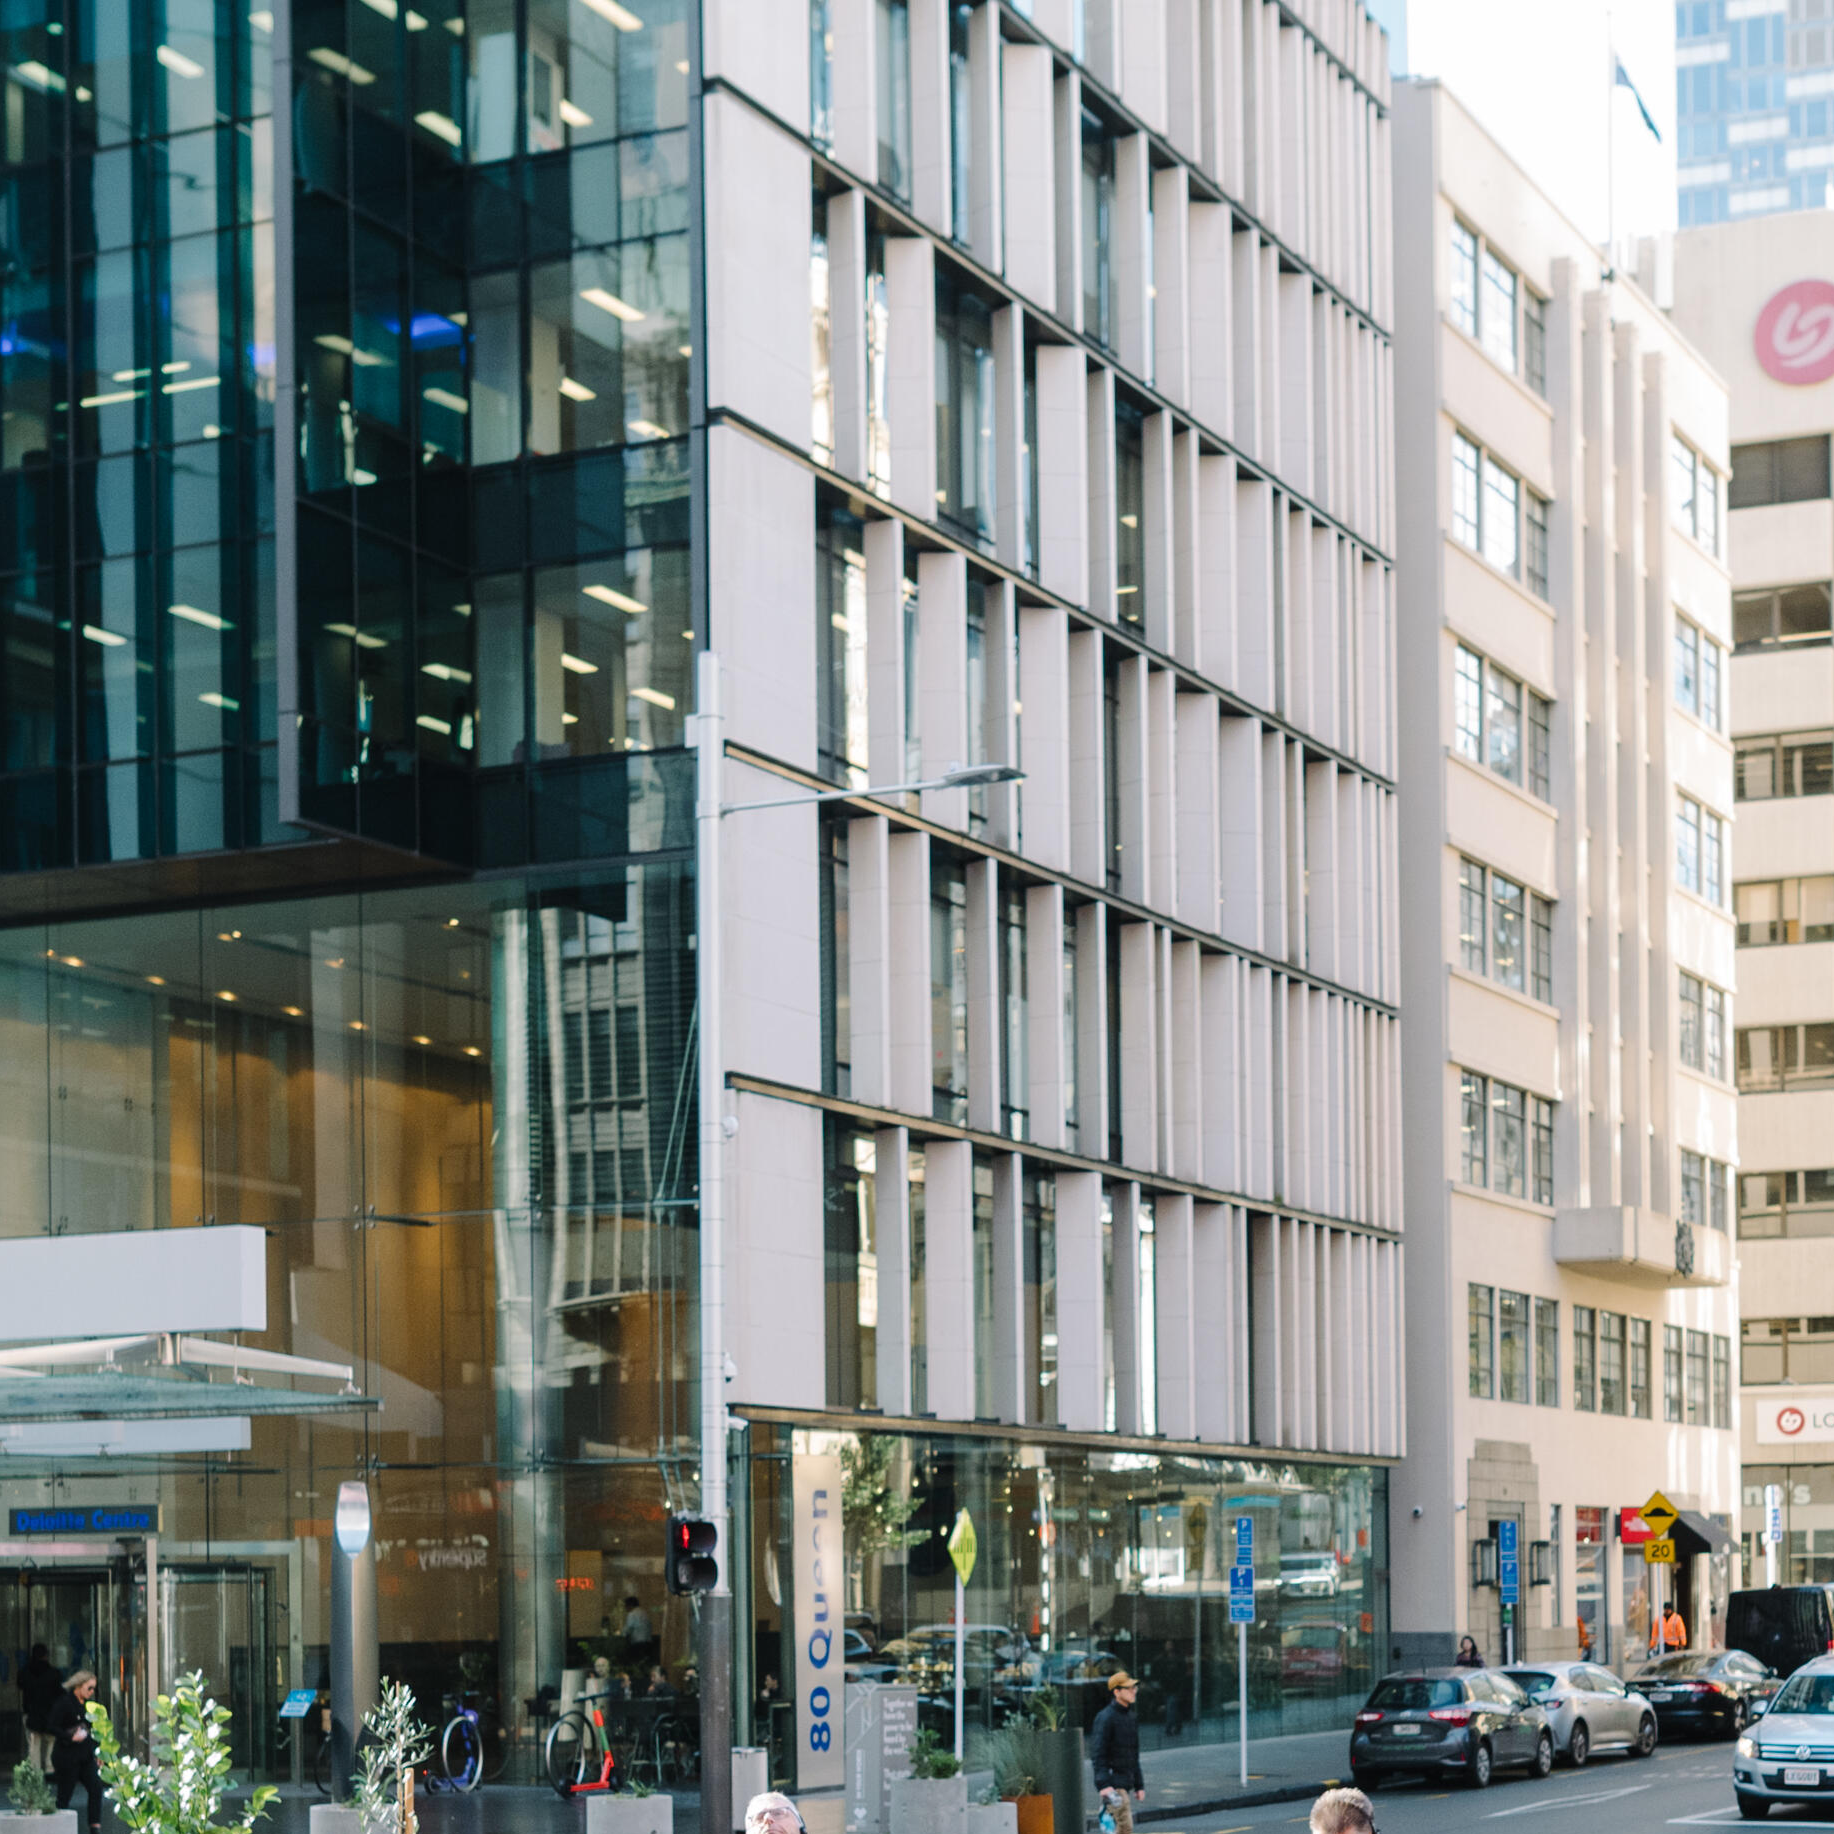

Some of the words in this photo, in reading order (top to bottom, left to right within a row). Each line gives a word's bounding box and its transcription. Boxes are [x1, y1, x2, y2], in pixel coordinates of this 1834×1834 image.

[17, 1511, 86, 1532] Deloitte
[91, 1509, 150, 1530] Centre
[1651, 1544, 1670, 1558] 20
[808, 1490, 832, 1669] Queen
[810, 1686, 831, 1753] 80
